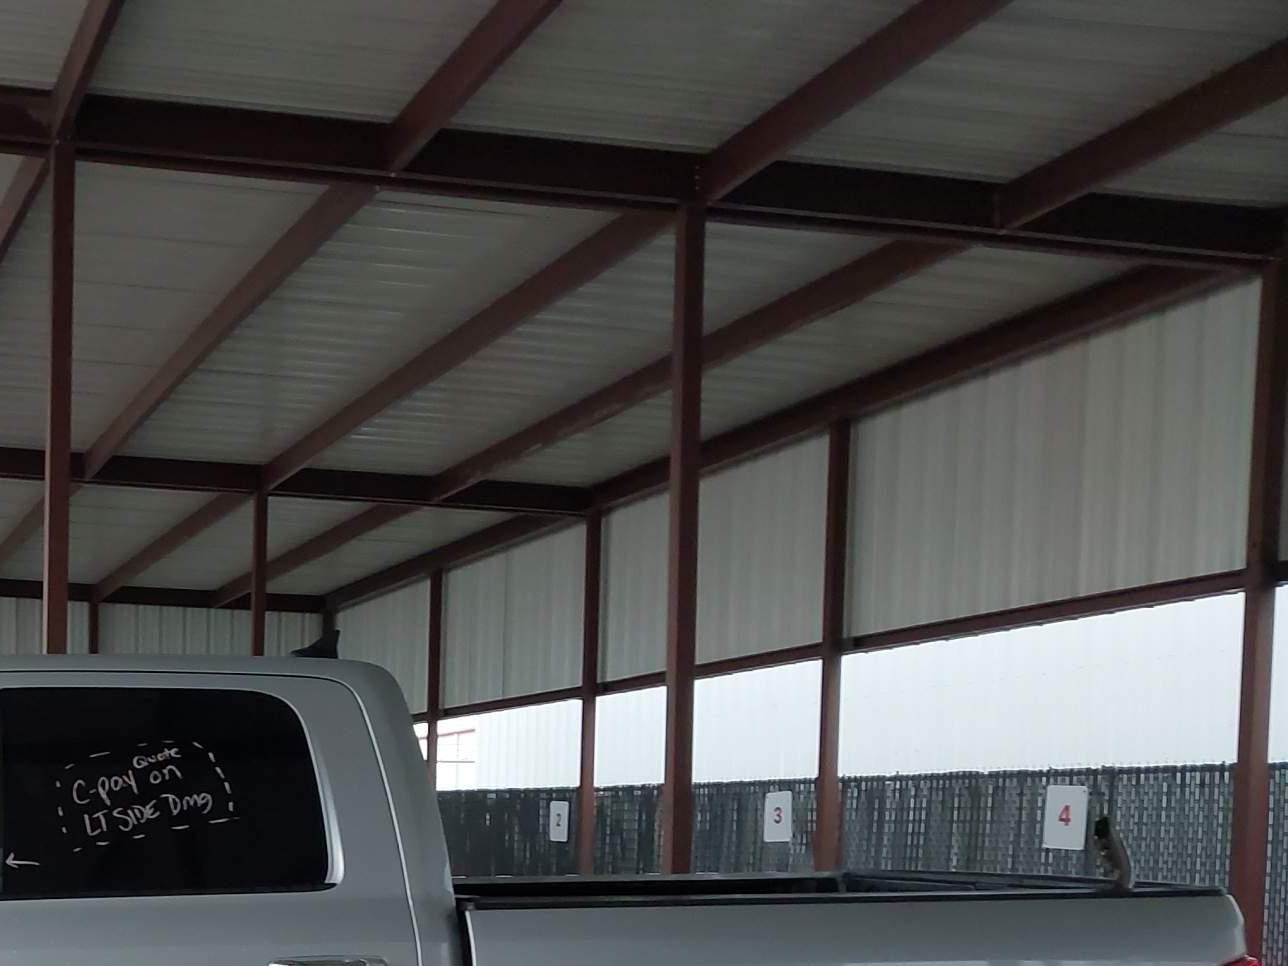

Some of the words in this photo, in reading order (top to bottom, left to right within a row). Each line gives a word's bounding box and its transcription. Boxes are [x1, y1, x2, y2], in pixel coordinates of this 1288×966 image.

[132, 747, 182, 769] Quote
[149, 764, 183, 784] on
[83, 809, 109, 836] LT
[113, 799, 161, 832] SIDE
[555, 812, 562, 827] 2
[774, 806, 782, 824] 3
[1058, 804, 1071, 826] 4
